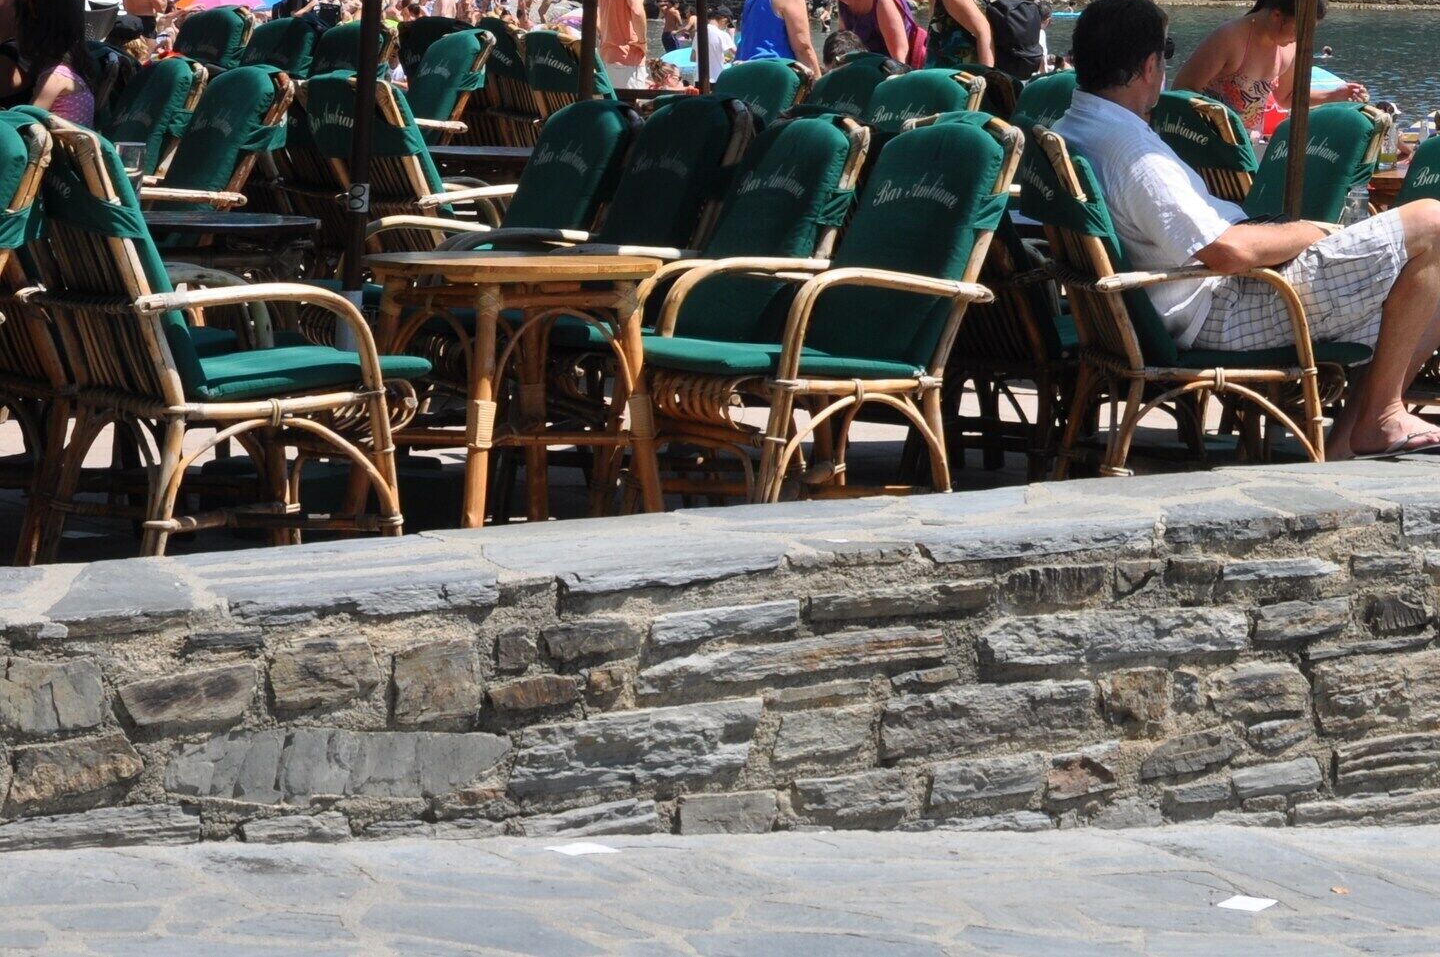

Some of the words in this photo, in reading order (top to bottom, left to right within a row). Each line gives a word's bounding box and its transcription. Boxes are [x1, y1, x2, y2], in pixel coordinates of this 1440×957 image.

[871, 105, 892, 123] Bar
[1159, 113, 1208, 146] Ambiance
[1270, 140, 1288, 162] Ba
[1022, 158, 1055, 201] biance
[1412, 166, 1440, 188] Bar
[872, 180, 902, 207] Bar
[905, 172, 959, 210] Ambiance
